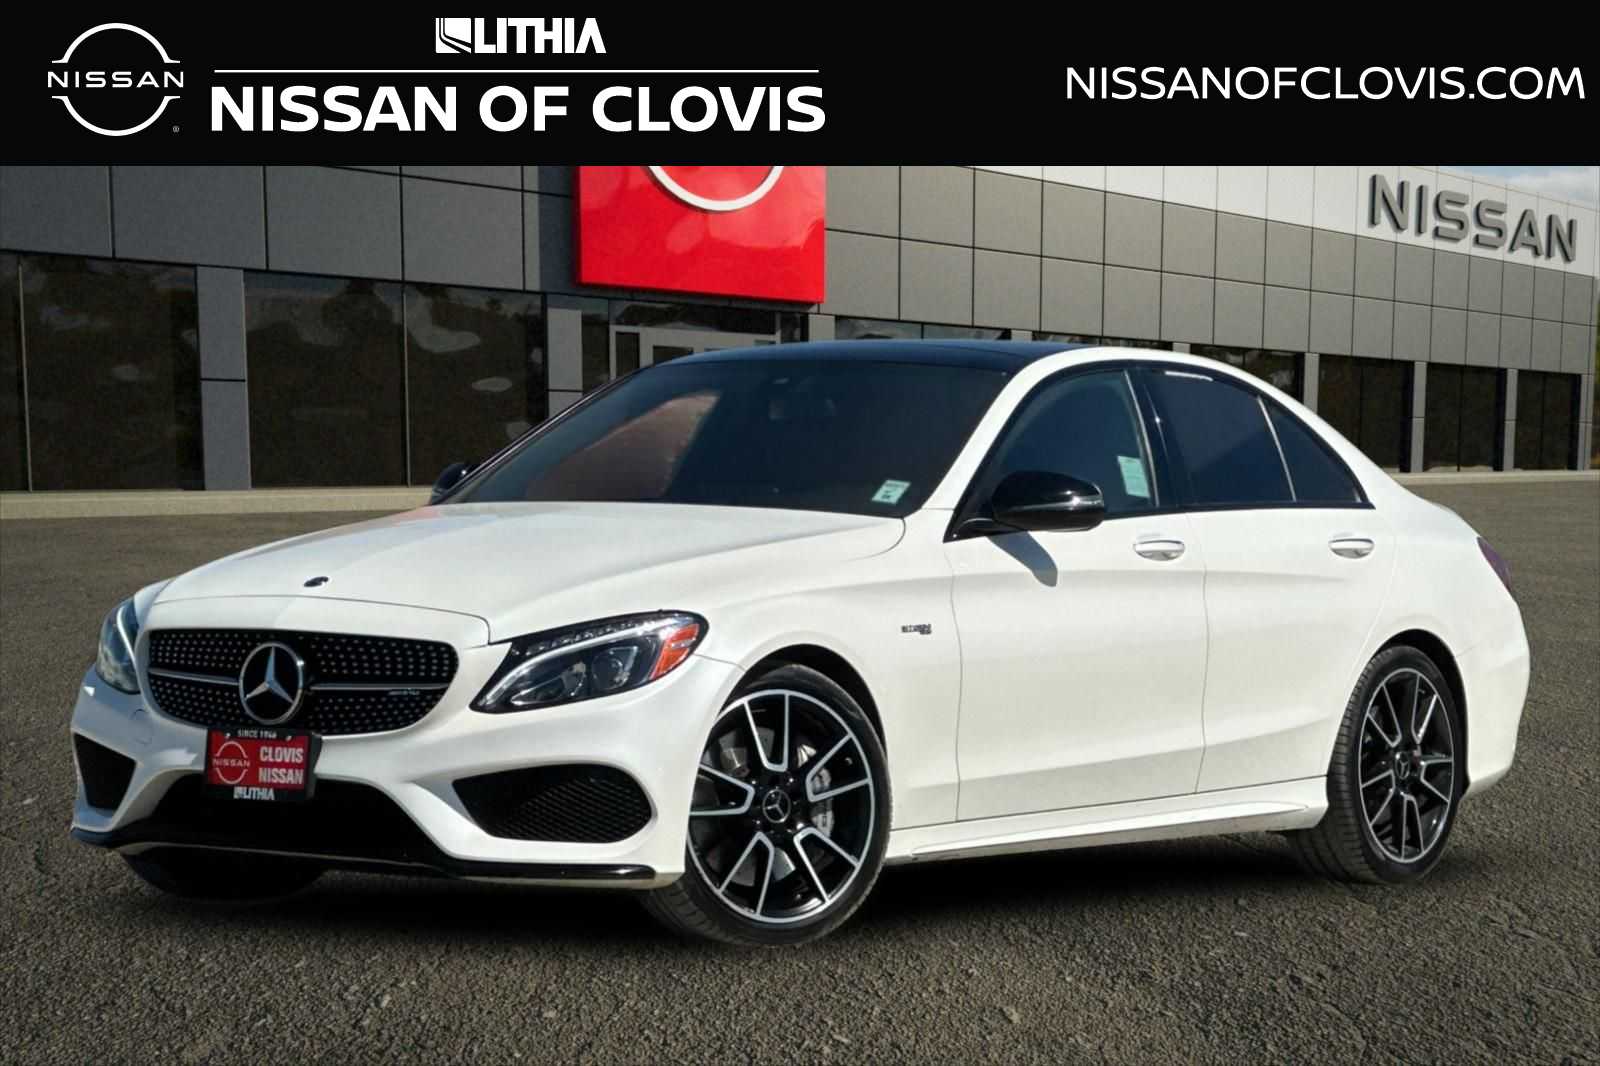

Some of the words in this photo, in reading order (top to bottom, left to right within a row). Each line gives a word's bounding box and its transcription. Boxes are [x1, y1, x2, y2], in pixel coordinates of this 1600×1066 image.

[1368, 173, 1577, 263] NISSAN
[212, 758, 250, 767] NISSAN
[259, 746, 304, 763] CLOVIS
[258, 767, 304, 785] NISSAN
[243, 787, 275, 800] LITHIA
